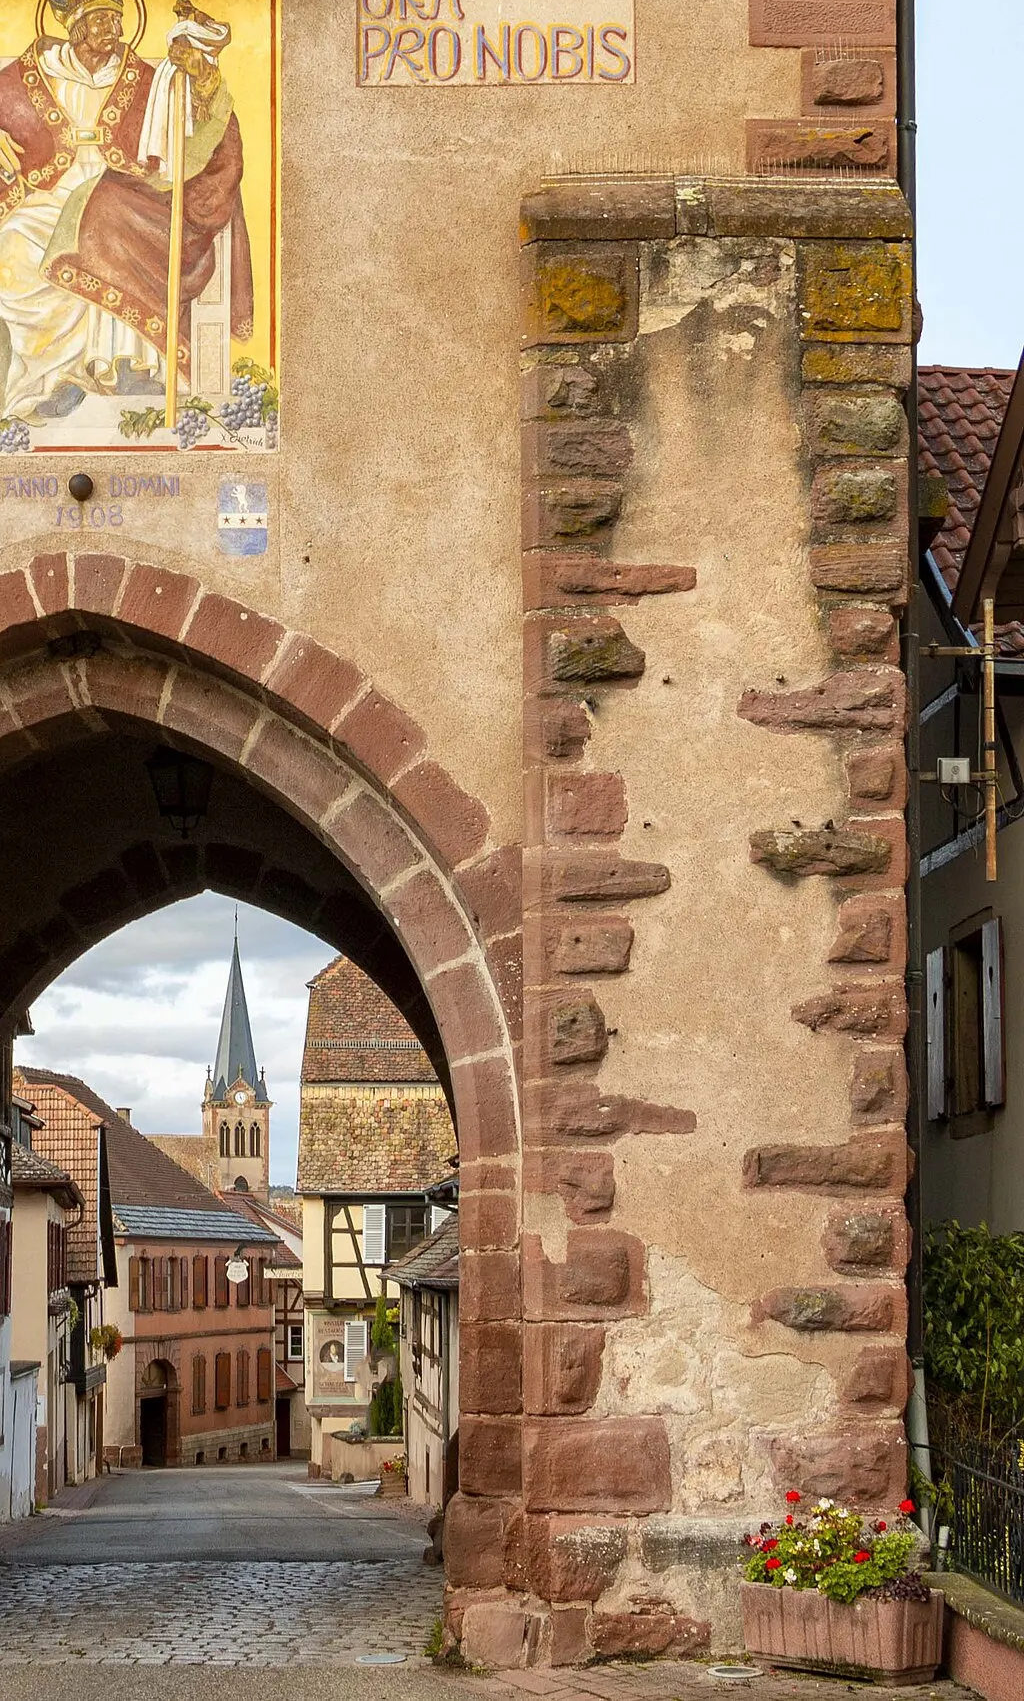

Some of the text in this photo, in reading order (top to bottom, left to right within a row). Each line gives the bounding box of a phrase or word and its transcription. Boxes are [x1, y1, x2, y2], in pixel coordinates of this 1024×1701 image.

[360, 21, 632, 83] PRO NOBIS
[3, 475, 181, 498] ANNO DOMINI
[56, 505, 124, 528] 1908
